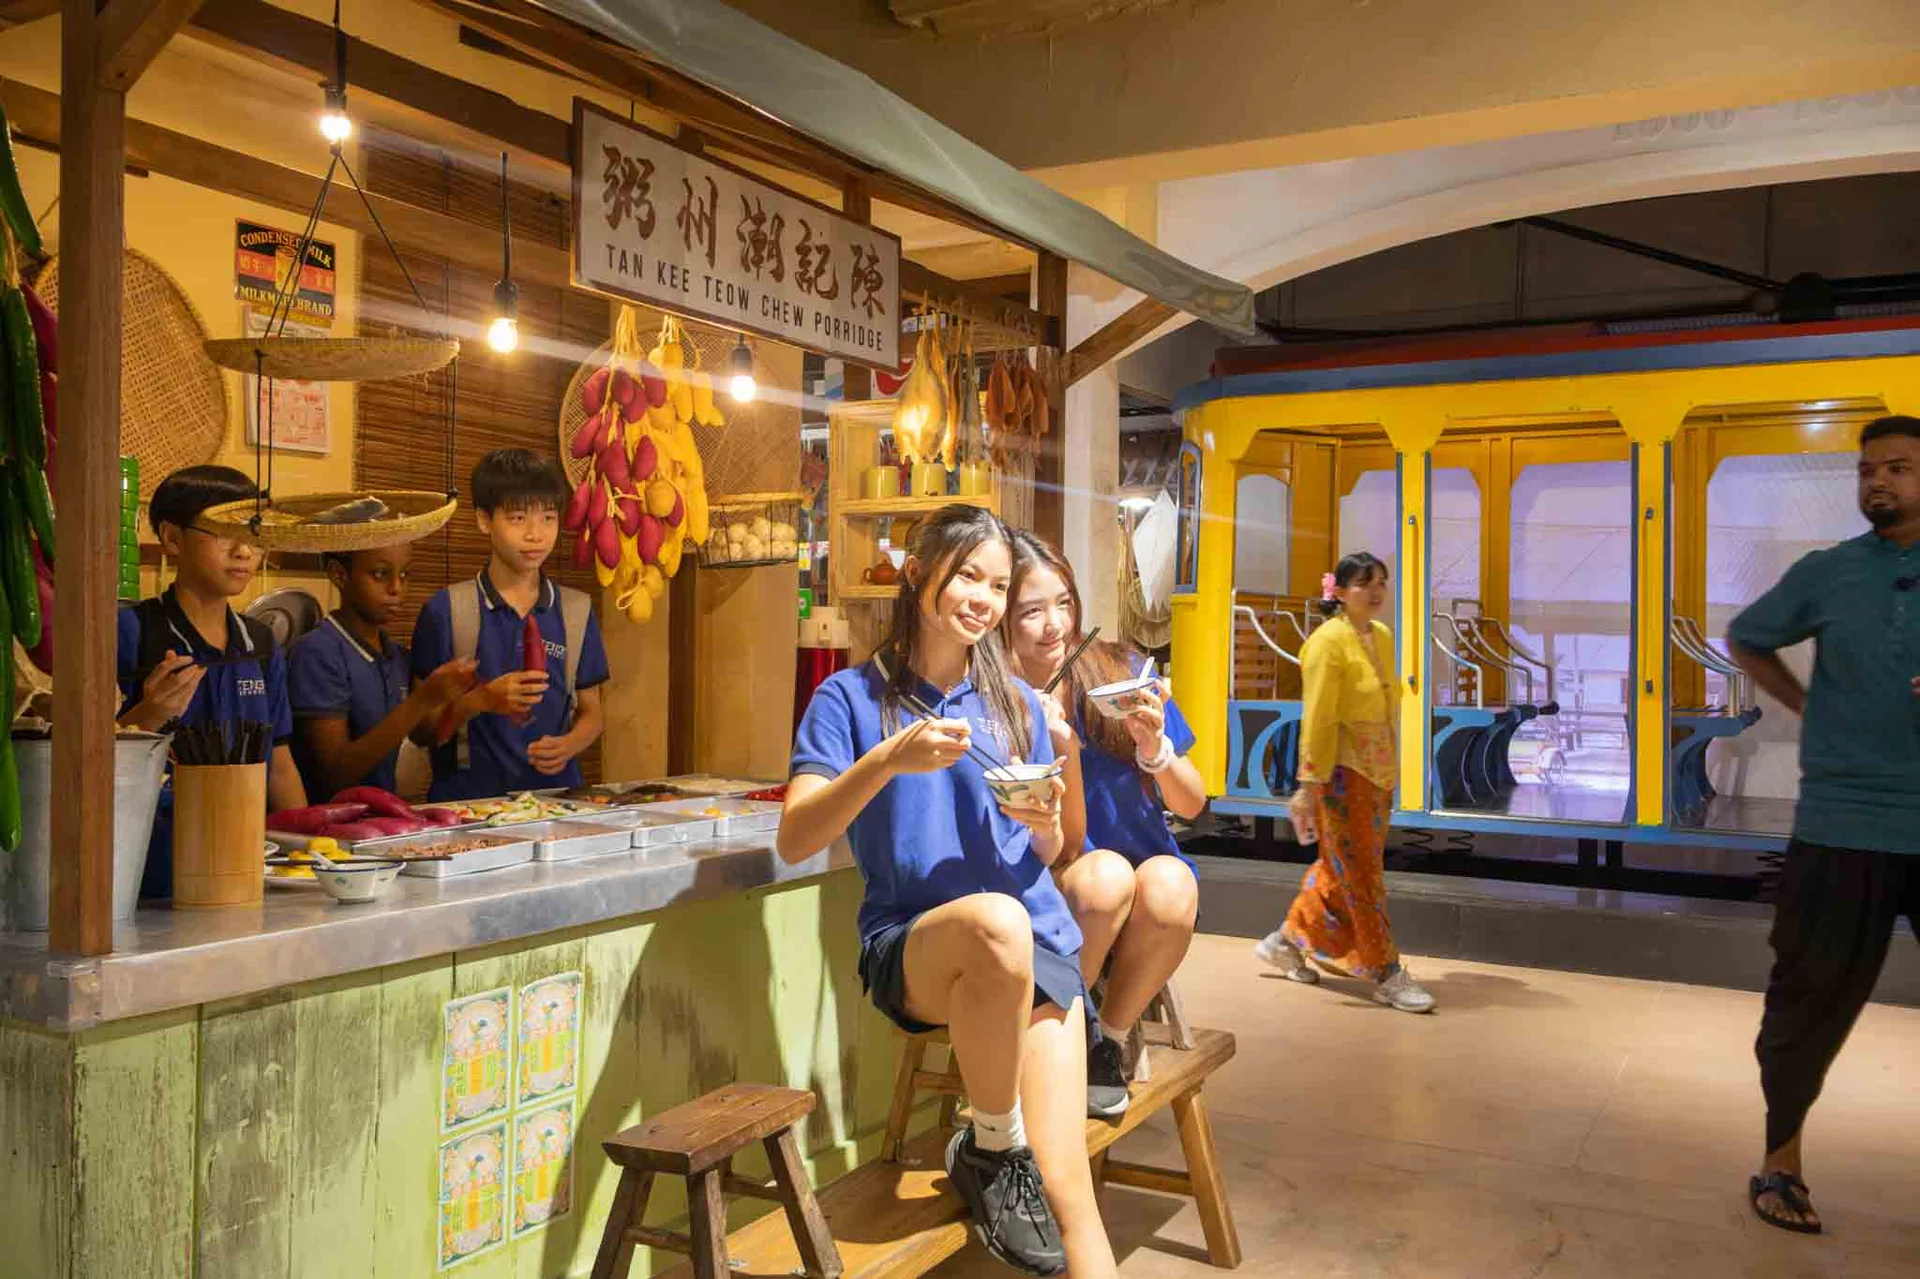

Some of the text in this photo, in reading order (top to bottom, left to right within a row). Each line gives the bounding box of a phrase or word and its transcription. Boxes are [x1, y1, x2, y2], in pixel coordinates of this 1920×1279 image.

[297, 298, 333, 316] BRAND
[605, 244, 883, 352] TAN KEE TEOW CHEW PORRIDGE
